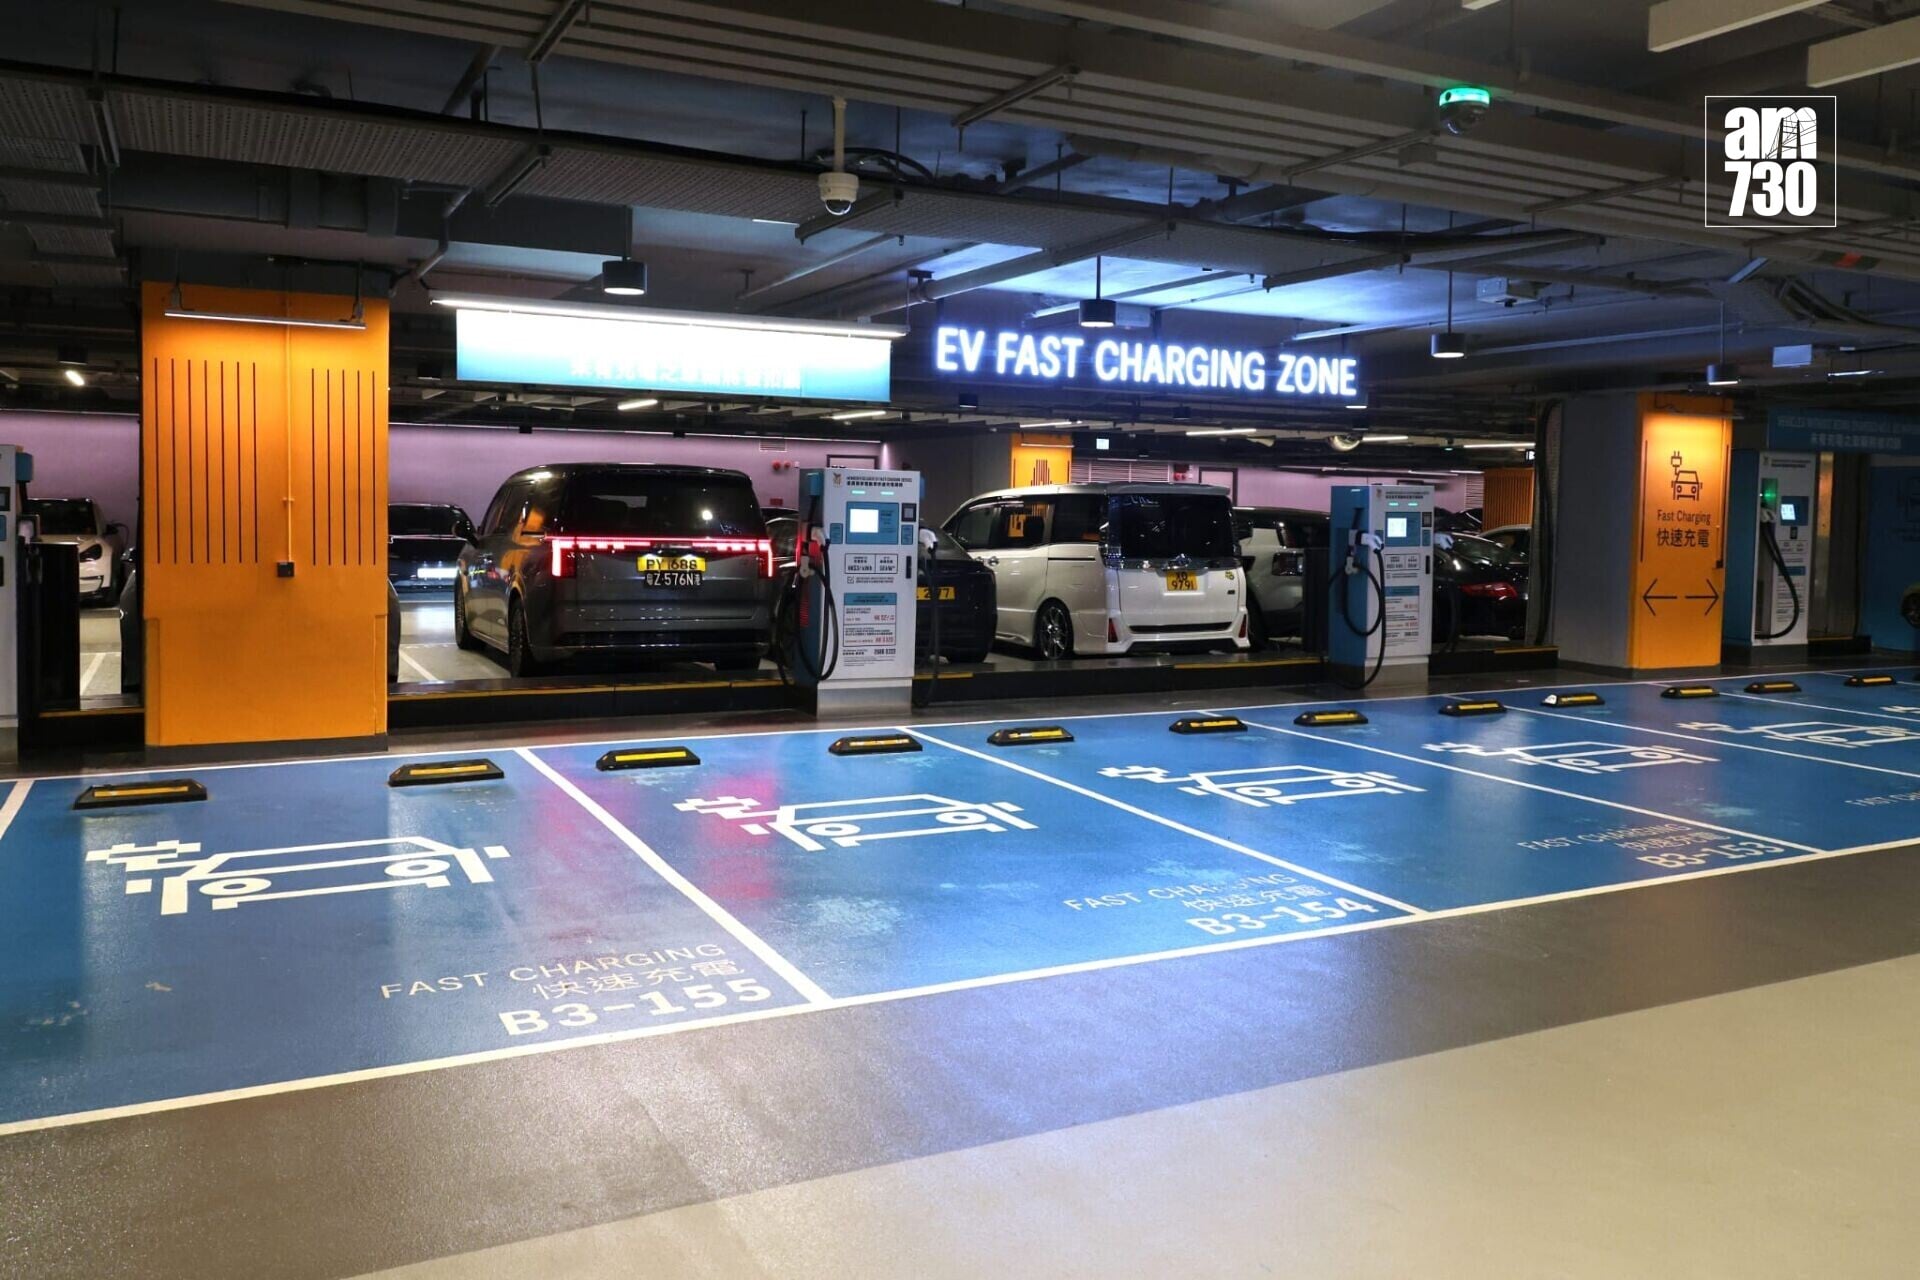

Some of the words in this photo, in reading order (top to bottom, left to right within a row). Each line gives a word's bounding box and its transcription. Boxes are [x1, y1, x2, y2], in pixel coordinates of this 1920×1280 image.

[936, 327, 985, 372] EV
[996, 332, 1084, 378] FAST
[1095, 341, 1266, 390] CHARGING
[1276, 354, 1357, 396] ZONE
[1657, 509, 1674, 521] Fast
[1677, 510, 1711, 526] Charging
[1656, 528, 1710, 547] 快速充電
[1171, 580, 1194, 590] 9791
[1517, 837, 1582, 850] FAST
[1577, 823, 1691, 842] CHARGING
[1636, 841, 1785, 868] B3-153
[1063, 891, 1142, 912] FAST
[1185, 897, 1379, 936] B3-154
[381, 972, 488, 999] FAST
[509, 944, 726, 983] CHARGING
[532, 959, 745, 1000] 快速充電
[498, 977, 772, 1036] B3-155
